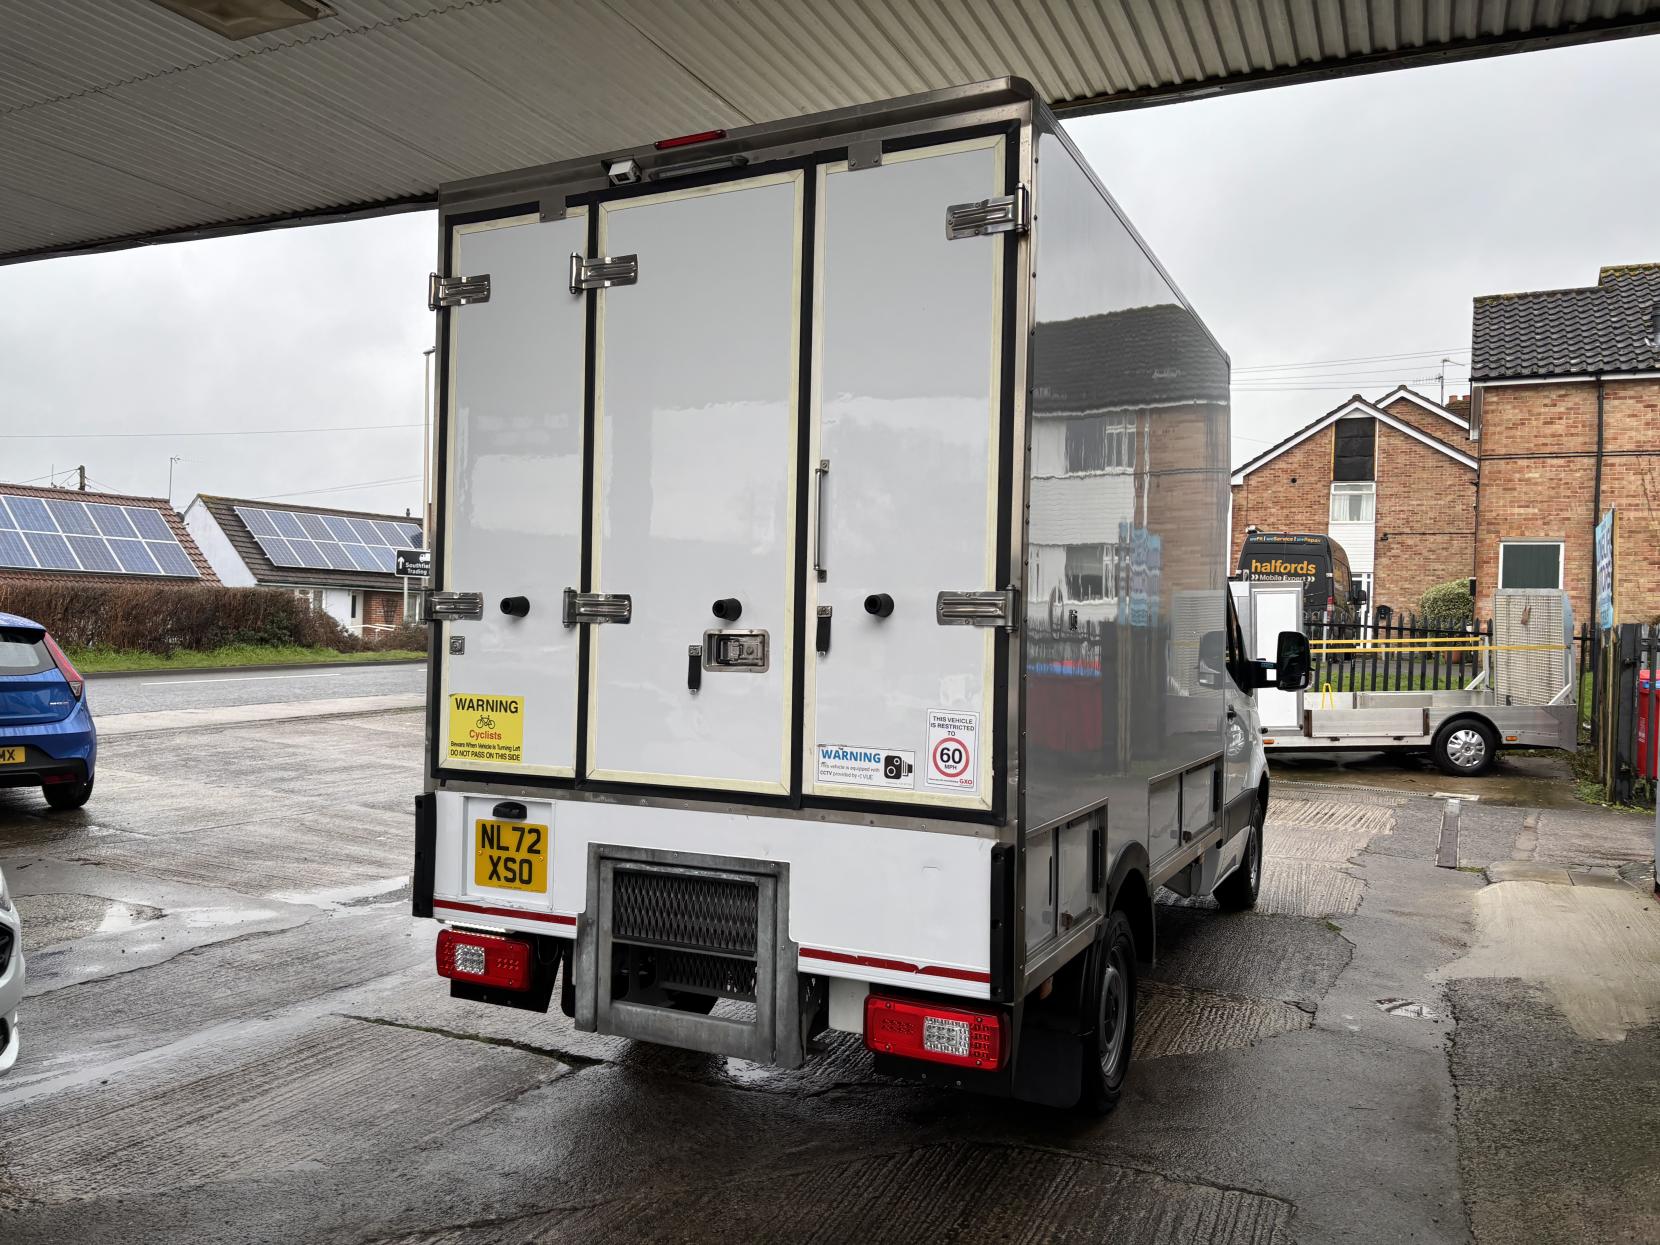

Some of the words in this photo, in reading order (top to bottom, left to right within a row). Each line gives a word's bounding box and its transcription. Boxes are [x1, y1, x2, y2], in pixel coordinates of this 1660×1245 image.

[1251, 559, 1316, 575] halfords
[455, 697, 519, 714] WARNING
[933, 715, 947, 723] THIS
[947, 717, 973, 725] VEHICLE
[937, 722, 975, 732] RESTRICTED
[469, 729, 502, 741] Cyclists
[478, 742, 493, 750] Vehicle
[497, 744, 512, 752] Turning
[471, 751, 485, 759] PASS
[495, 752, 508, 761] THIS
[508, 753, 521, 762] SIDE
[821, 748, 881, 764] WARNING
[940, 747, 963, 765] 60
[481, 823, 542, 855] NL72
[488, 854, 533, 885] XSO
